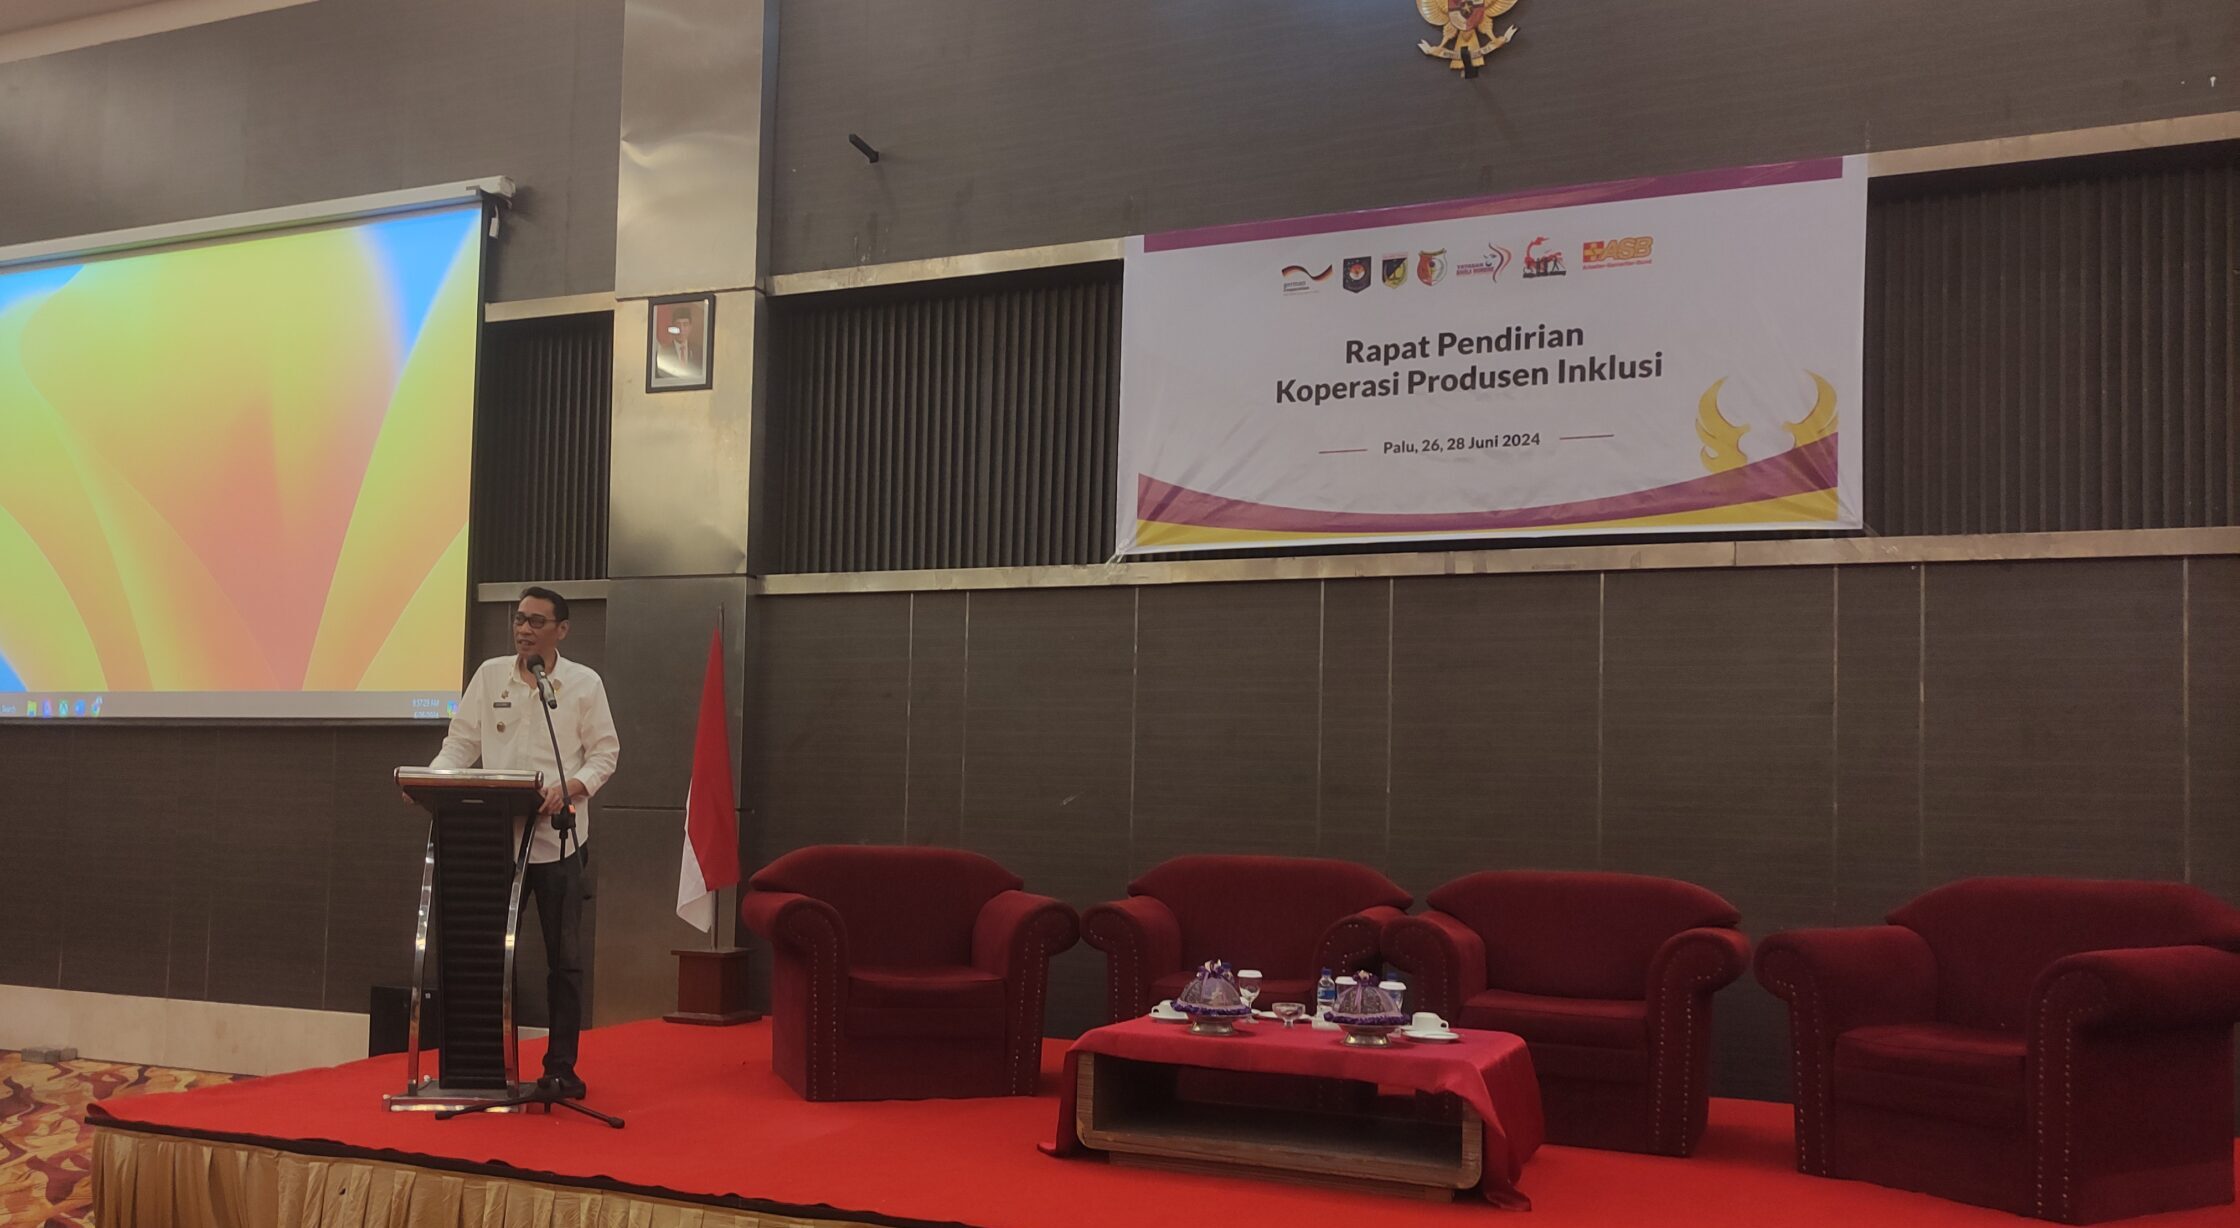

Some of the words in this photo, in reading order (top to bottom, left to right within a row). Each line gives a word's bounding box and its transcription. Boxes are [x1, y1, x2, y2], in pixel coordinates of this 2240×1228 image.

[1601, 236, 1654, 261] ASB
[1345, 336, 1430, 366] Rapat
[1438, 324, 1584, 356] Pendirian
[1276, 372, 1399, 406] Koperasi
[1408, 364, 1549, 394] Produsen
[1558, 351, 1663, 383] Inklusi
[1383, 441, 1419, 454] Palu,
[1422, 439, 1444, 453] 26,
[1446, 437, 1465, 451] 28
[1468, 435, 1499, 449] Juni
[1502, 432, 1541, 448] 2024
